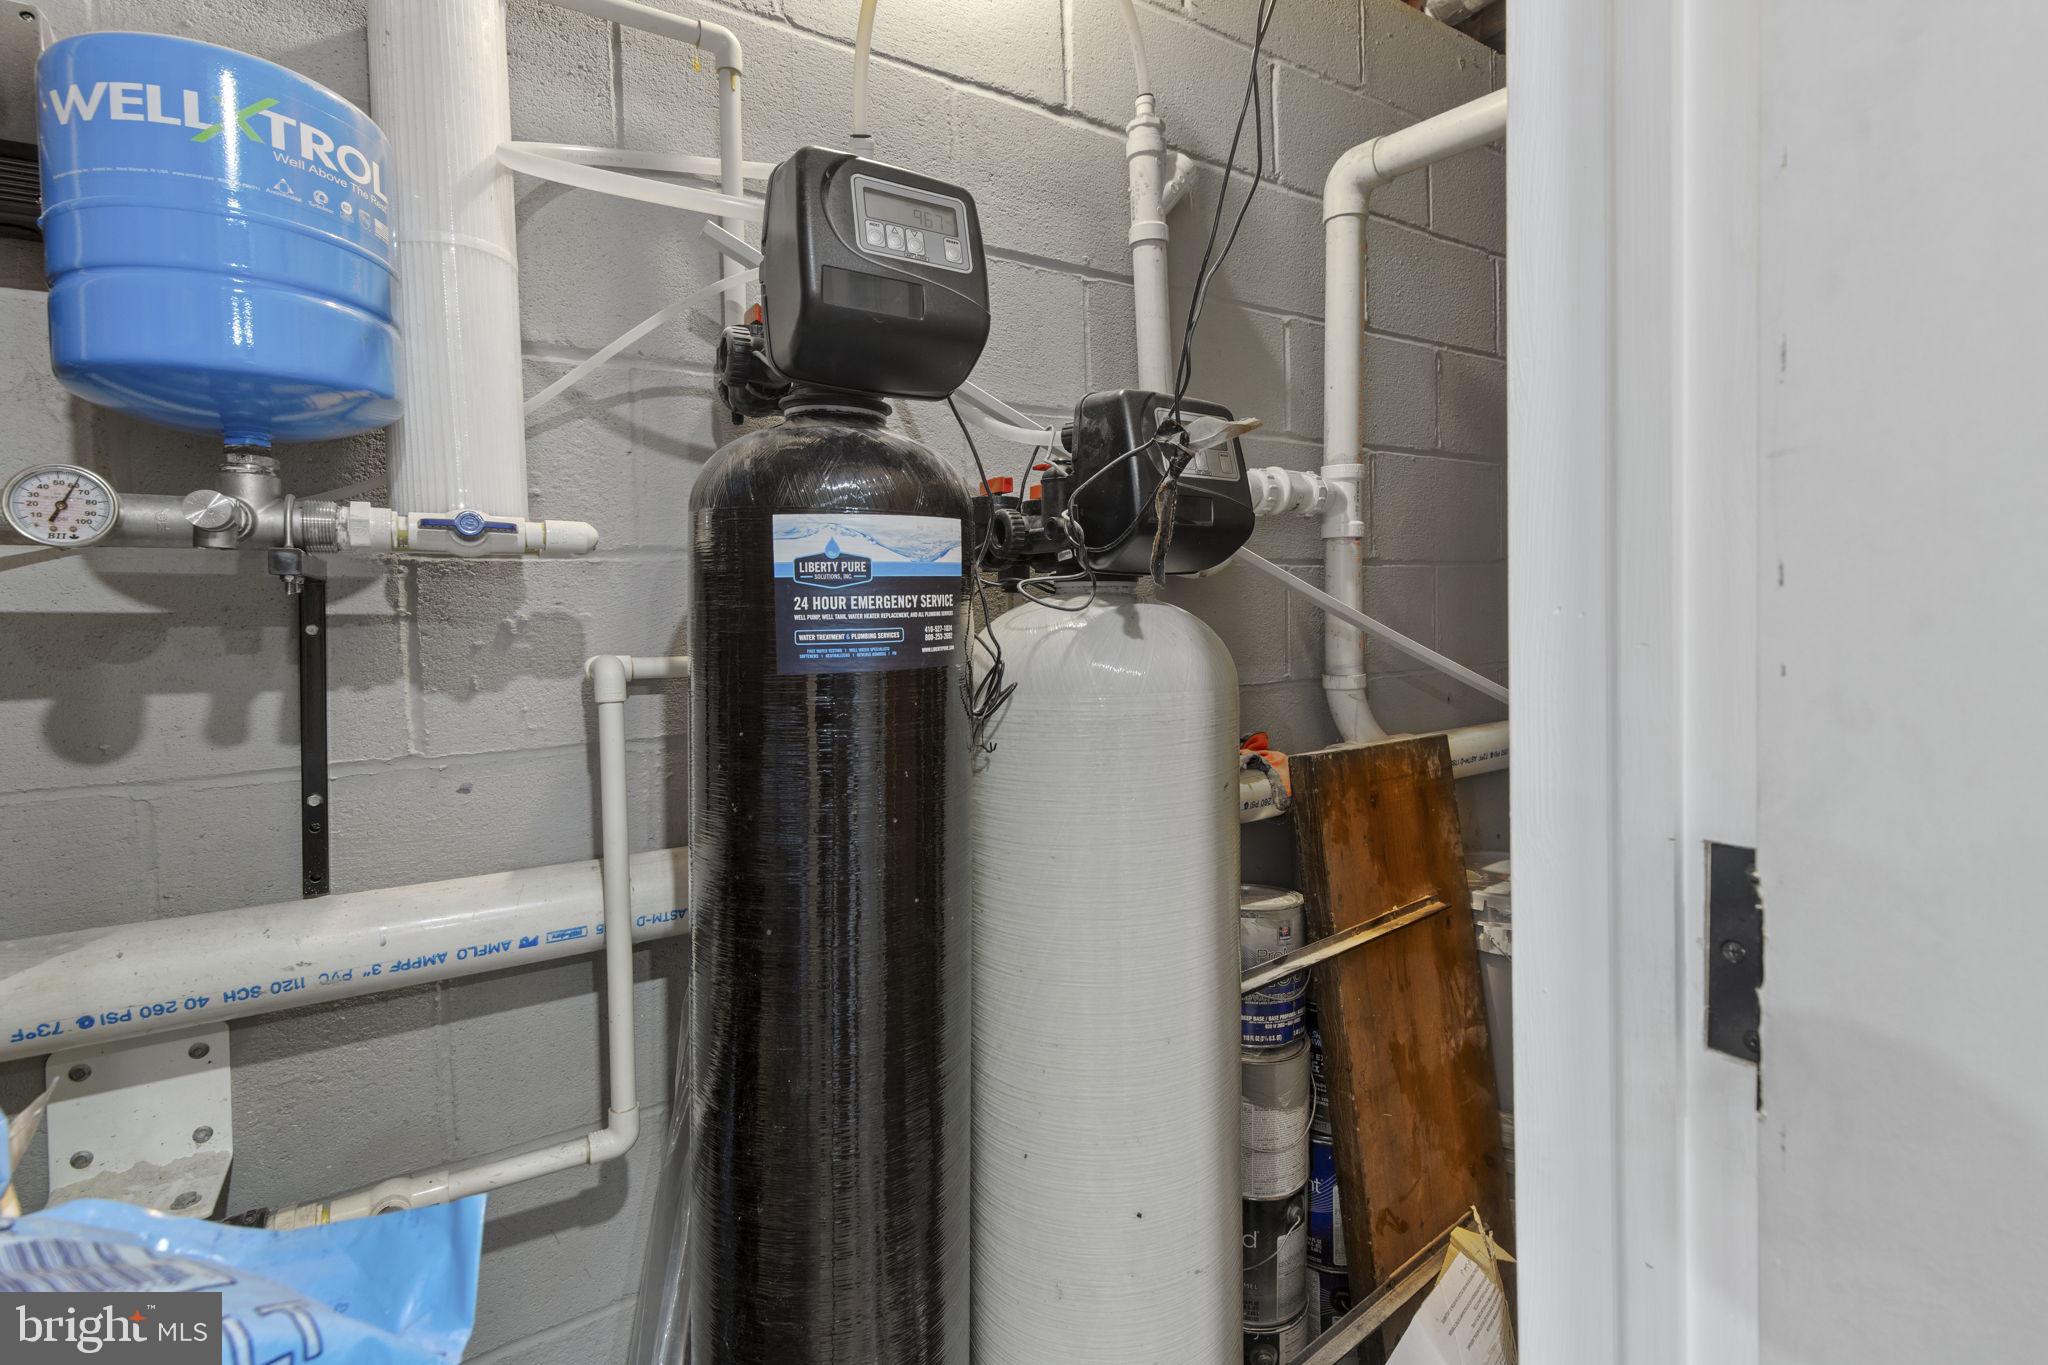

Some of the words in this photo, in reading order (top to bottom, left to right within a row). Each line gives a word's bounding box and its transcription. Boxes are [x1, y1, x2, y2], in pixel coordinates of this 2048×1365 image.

[273, 151, 305, 170] Well
[308, 164, 349, 188] Above
[350, 182, 369, 200] The
[799, 561, 839, 573] LIBERTY
[841, 561, 867, 572] PURE
[794, 596, 809, 611] 24
[812, 596, 847, 610] HOUR
[851, 594, 918, 610] EMERGENCY
[920, 594, 954, 608] SERVICE
[851, 632, 877, 640] PLUMBING
[877, 631, 900, 639] SERVICES
[635, 907, 690, 929] ASTM-D
[456, 939, 513, 961] AMFLO
[388, 951, 449, 973] AMPPF
[269, 976, 306, 995] 1120
[317, 967, 355, 988] PVC
[183, 995, 210, 1011] 40
[222, 985, 263, 1004] SCH
[100, 1008, 133, 1026] PSI
[139, 1001, 179, 1020] 260
